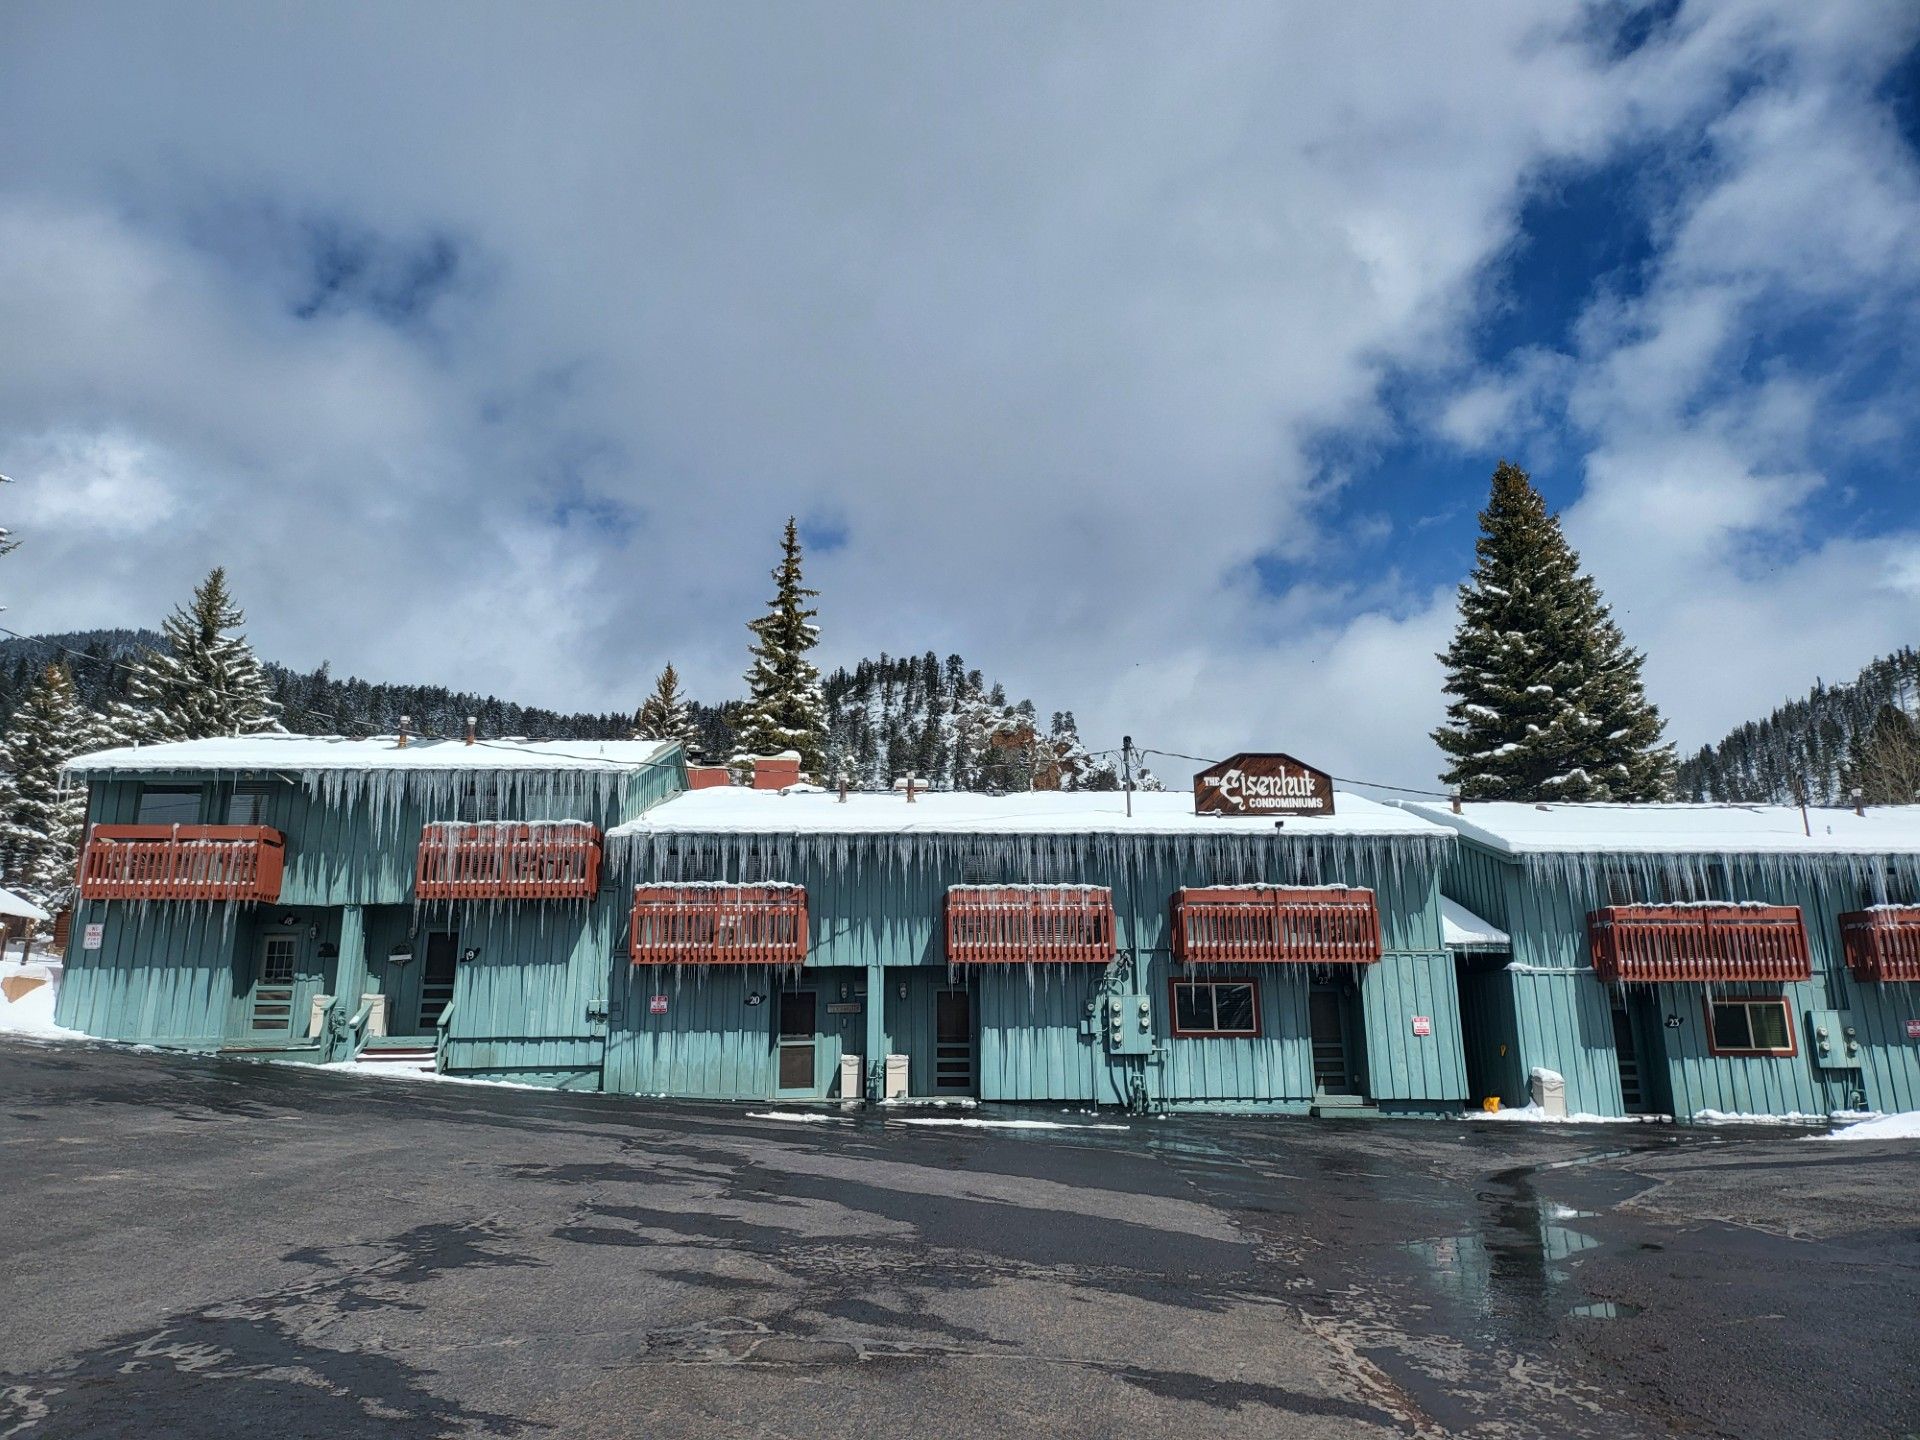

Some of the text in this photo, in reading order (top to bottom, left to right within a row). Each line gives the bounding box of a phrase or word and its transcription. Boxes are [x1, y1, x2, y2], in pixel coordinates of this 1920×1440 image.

[1203, 765, 1316, 811] THE Eisenhut
[1249, 797, 1324, 809] CONDOMINIUMS
[466, 950, 474, 961] 19
[1318, 976, 1329, 985] 22
[750, 995, 760, 1005] 20
[1669, 1018, 1680, 1027] 23
